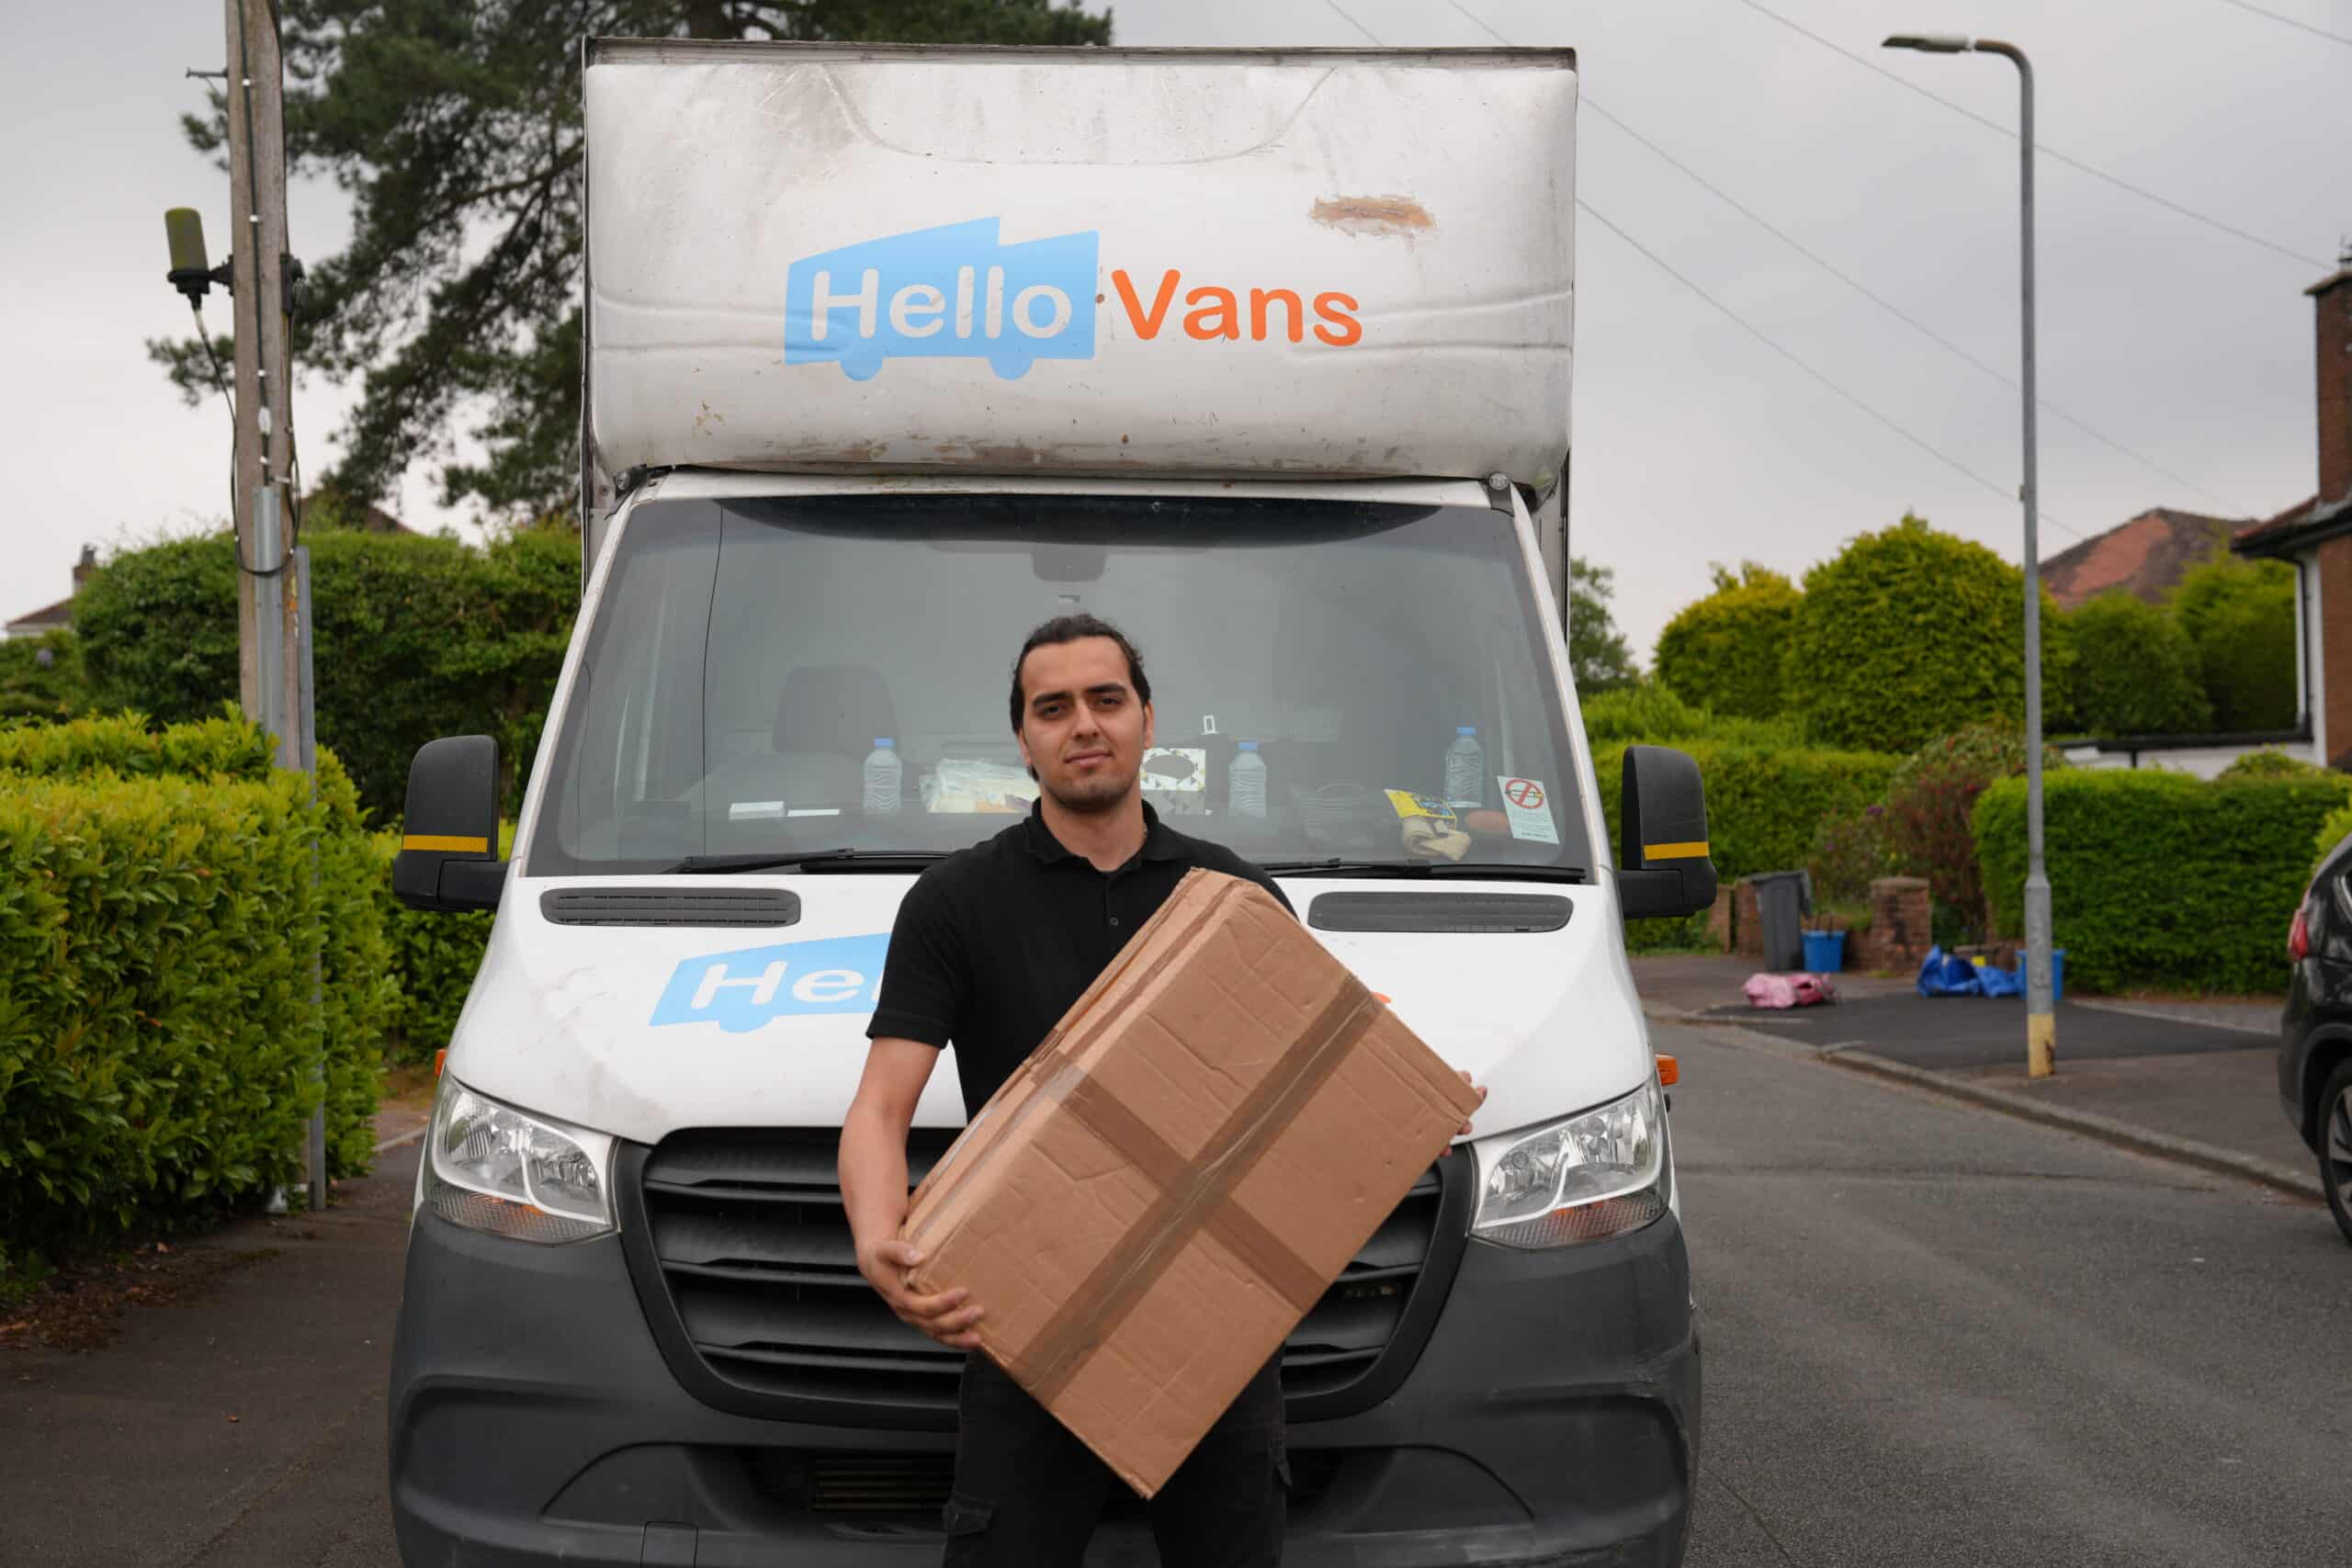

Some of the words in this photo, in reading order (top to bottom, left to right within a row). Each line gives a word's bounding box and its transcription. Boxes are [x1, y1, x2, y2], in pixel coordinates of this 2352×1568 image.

[811, 266, 1071, 341] Hello
[1110, 268, 1363, 347] Vans
[691, 961, 884, 1009] He
